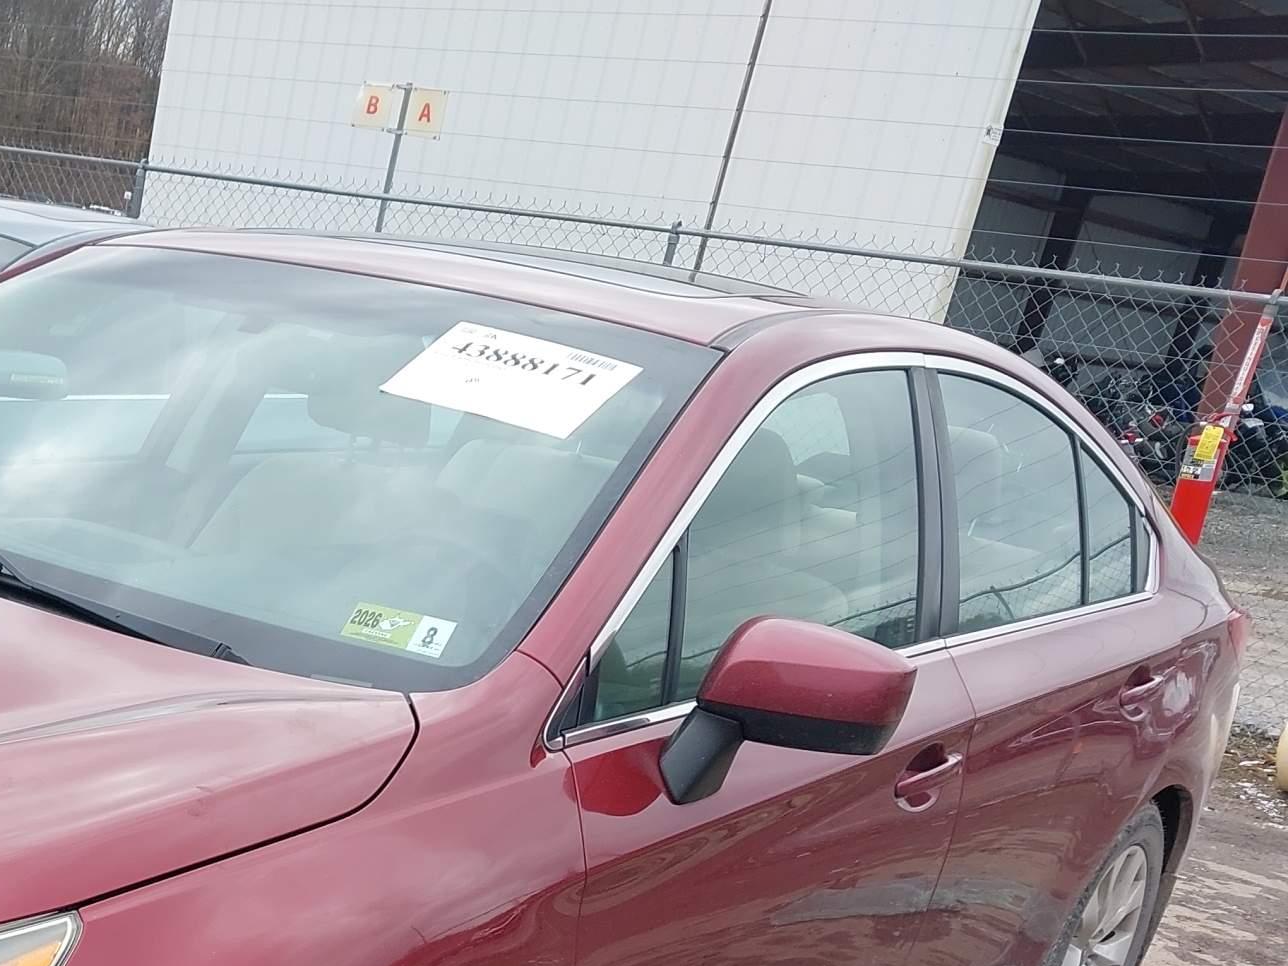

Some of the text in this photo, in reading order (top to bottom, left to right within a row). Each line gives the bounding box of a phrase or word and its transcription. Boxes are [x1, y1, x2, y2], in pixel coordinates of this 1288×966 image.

[366, 95, 380, 115] B
[418, 102, 431, 123] A
[451, 341, 597, 387] 43888171
[350, 608, 383, 629] 2026
[421, 626, 438, 646] 8
